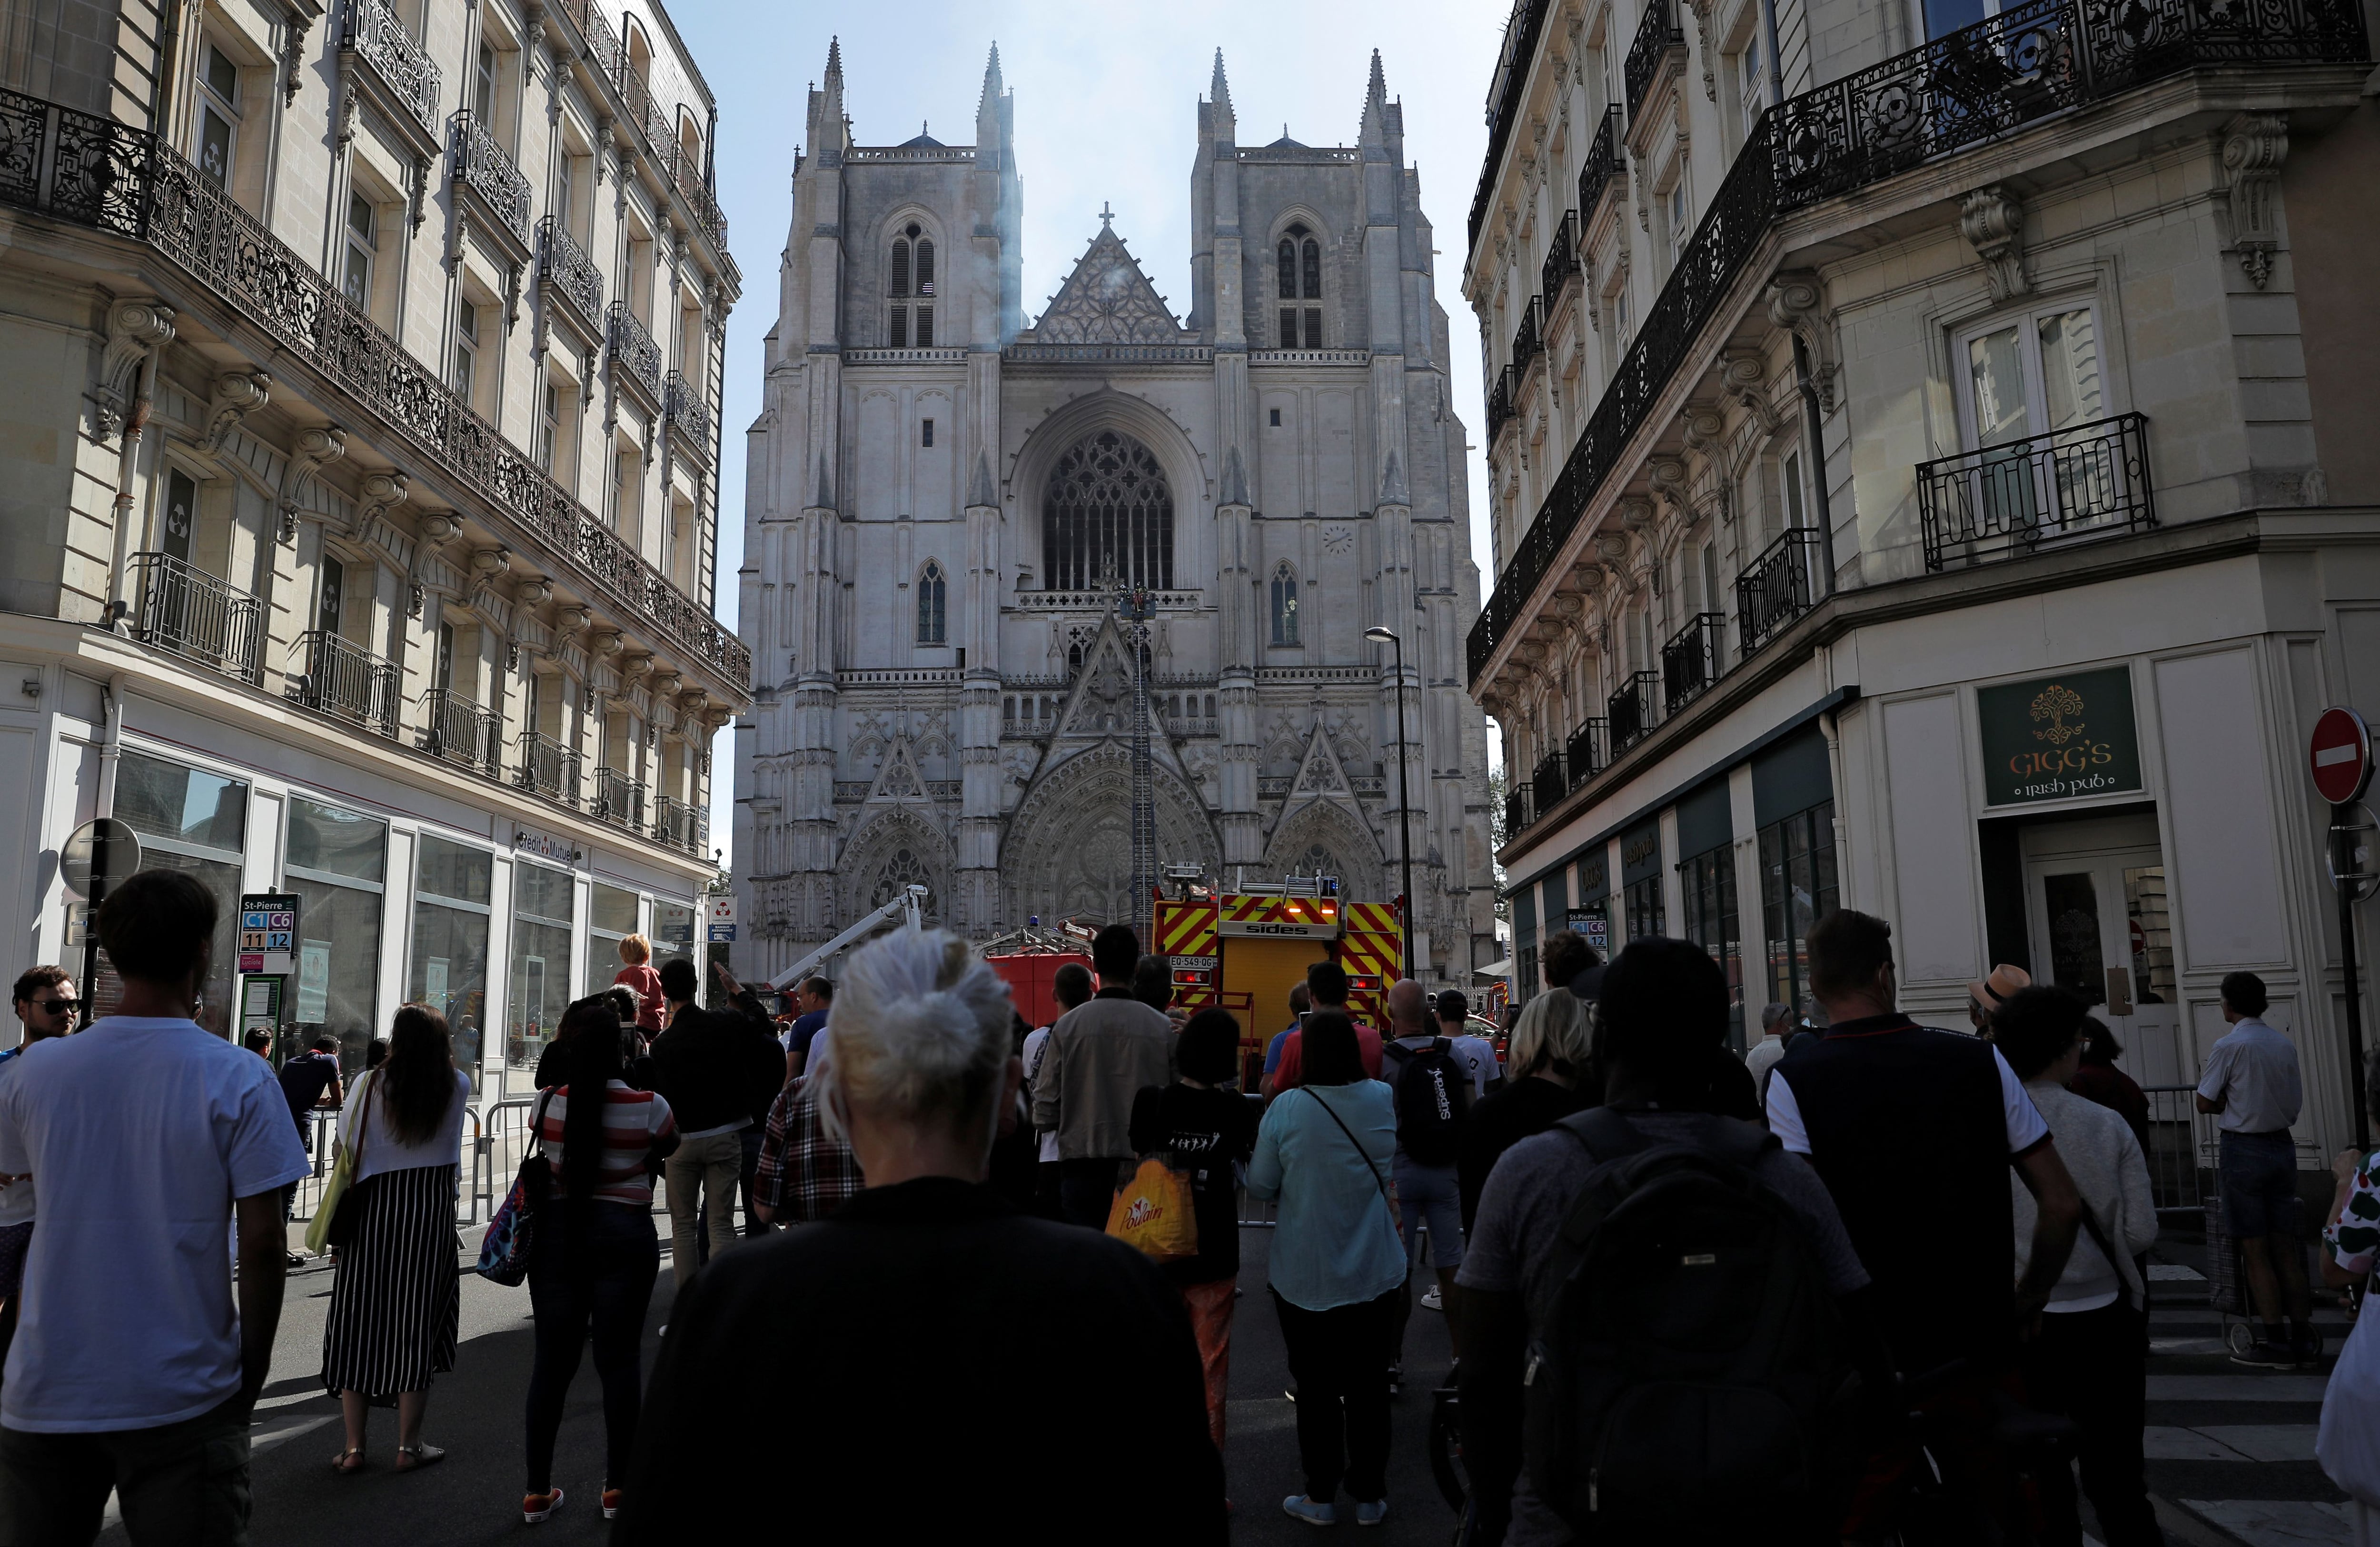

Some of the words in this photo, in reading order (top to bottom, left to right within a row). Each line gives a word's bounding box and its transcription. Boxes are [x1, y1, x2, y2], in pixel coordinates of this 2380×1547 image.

[2010, 739, 2112, 780] GIGG'S
[549, 840, 573, 862] Mutuel
[244, 901, 282, 910] St-Pierre
[246, 913, 264, 927] C1
[271, 913, 290, 927] C6
[1590, 922, 1604, 932] C6
[1246, 924, 1308, 935] sides
[246, 933, 261, 947] 11
[271, 933, 288, 947] 12
[1592, 936, 1604, 946] 12
[1171, 957, 1212, 967] EQ-549-QG
[1120, 1203, 1163, 1232] Poulain
